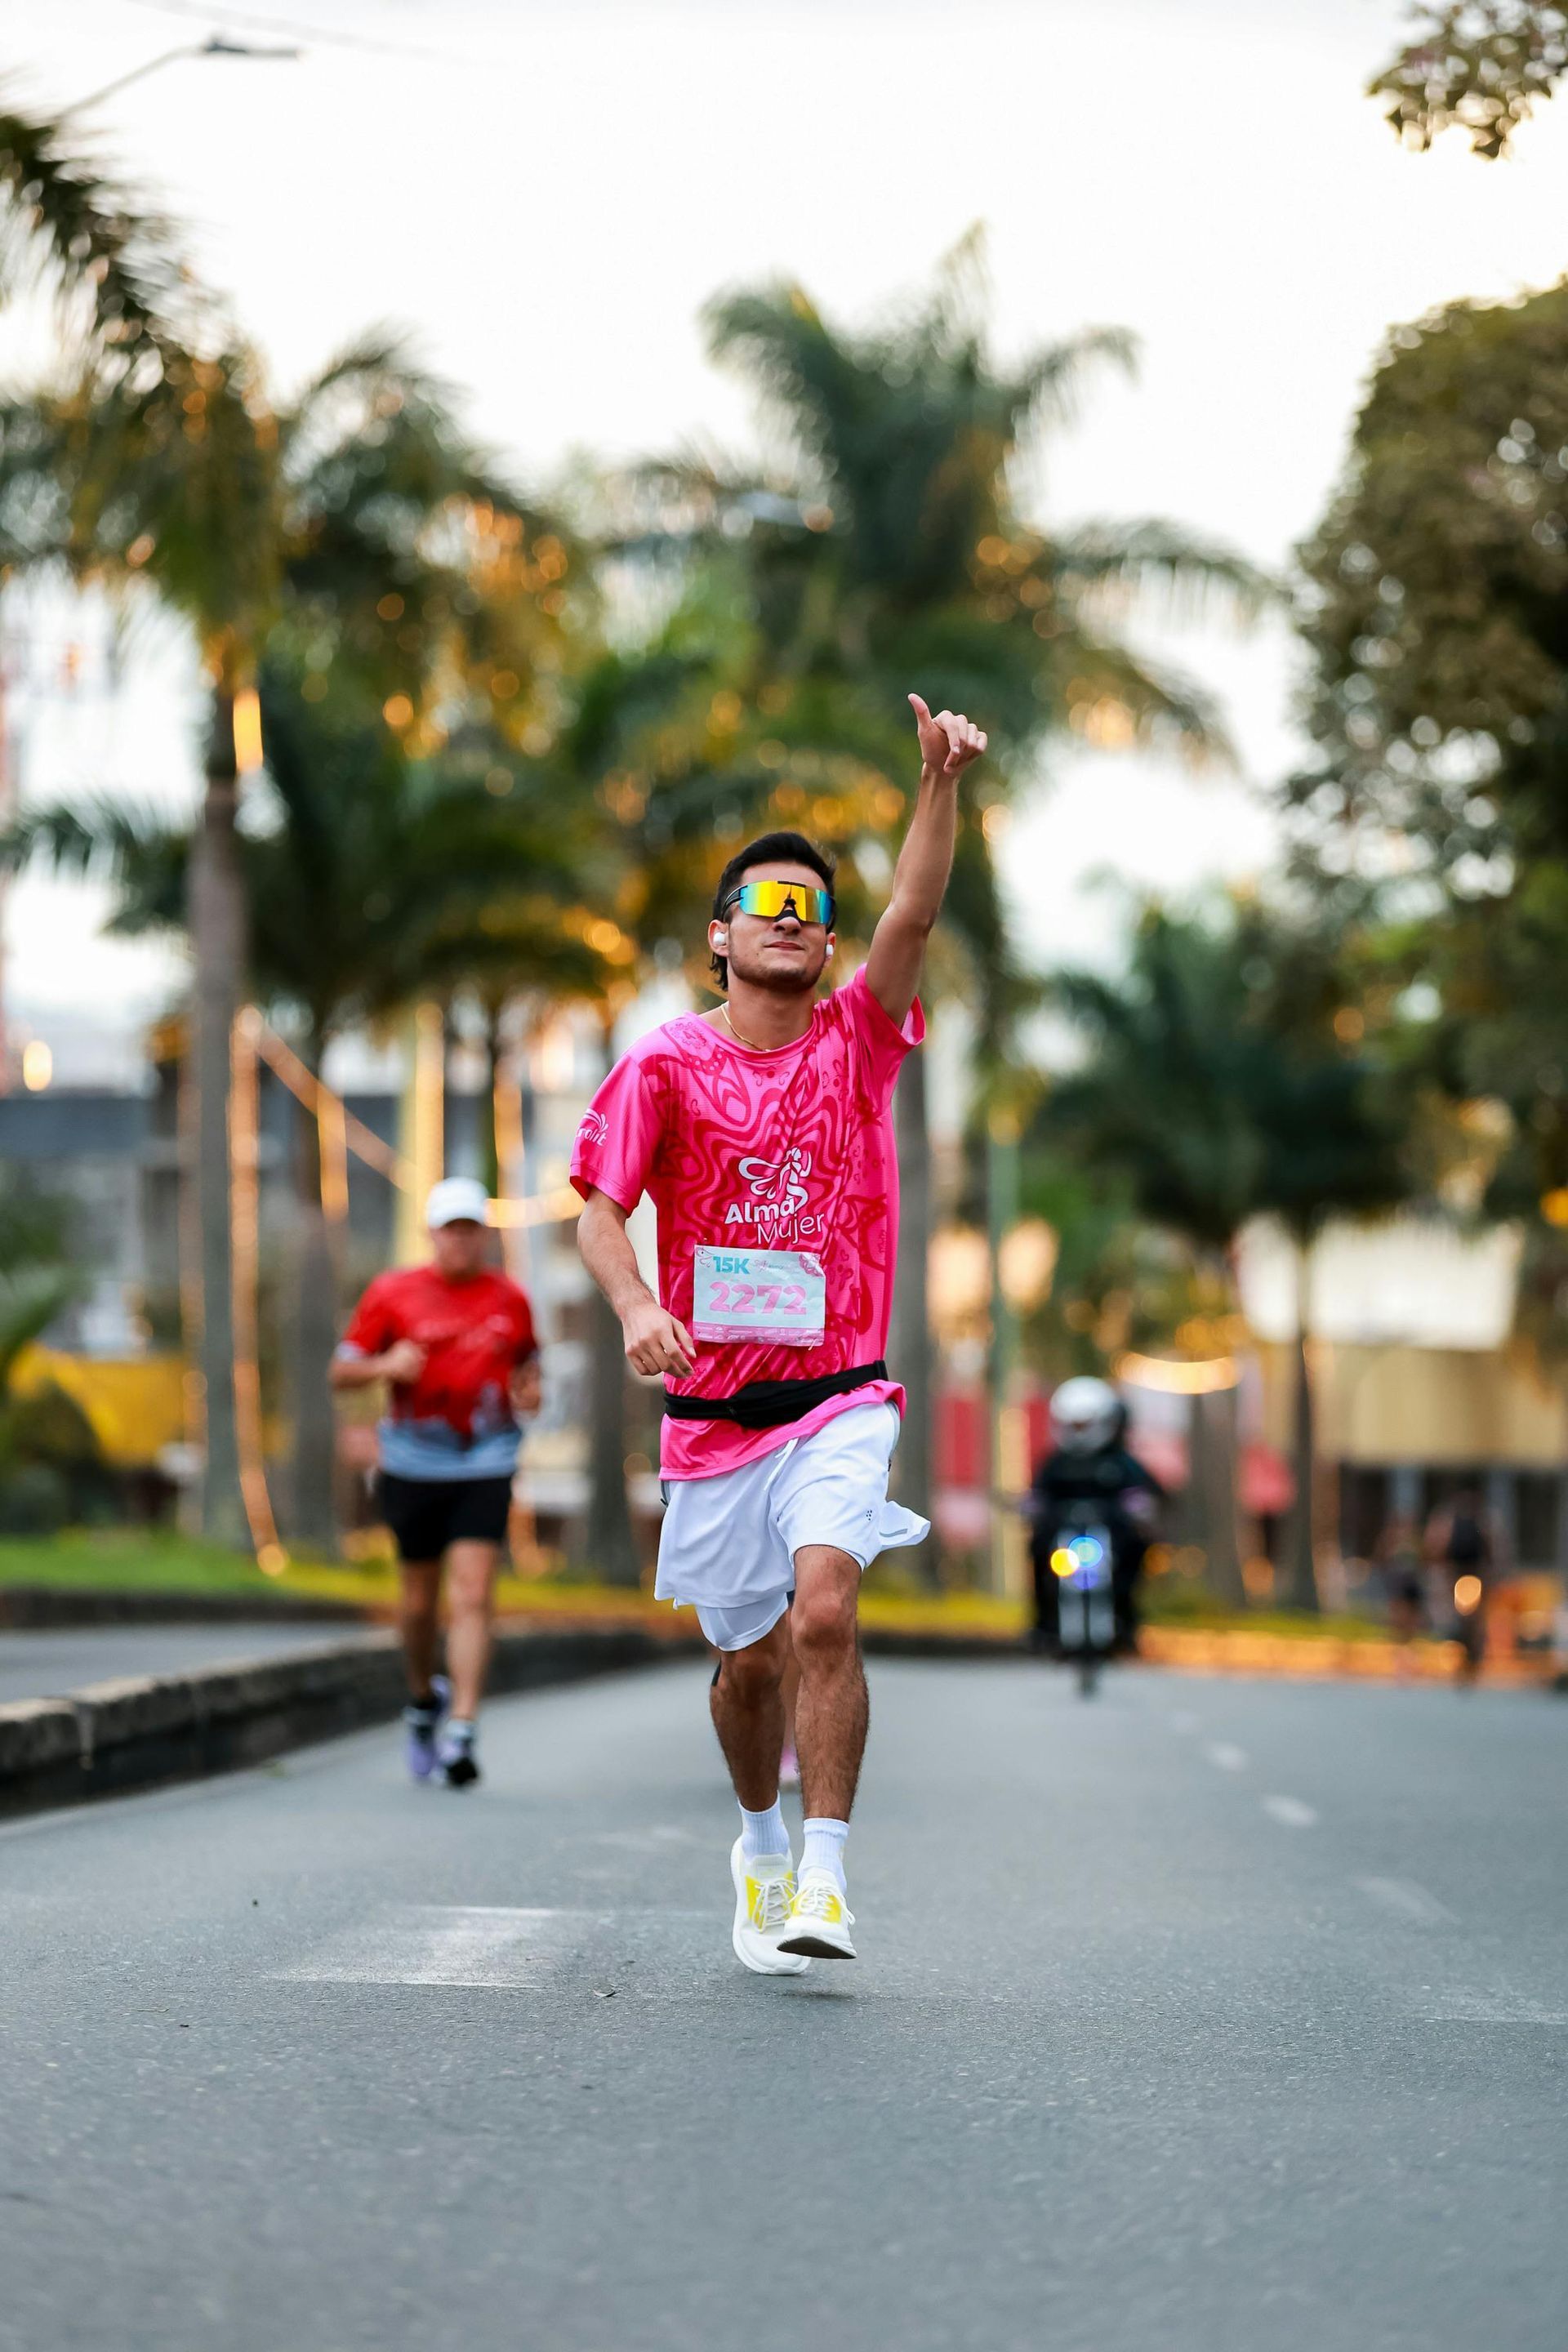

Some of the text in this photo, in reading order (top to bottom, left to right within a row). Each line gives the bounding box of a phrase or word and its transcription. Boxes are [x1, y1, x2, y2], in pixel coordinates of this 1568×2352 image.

[724, 1197, 795, 1224] Alma
[757, 1213, 825, 1245] Mujer
[713, 1256, 750, 1275] 15K
[709, 1281, 806, 1315] 2272
